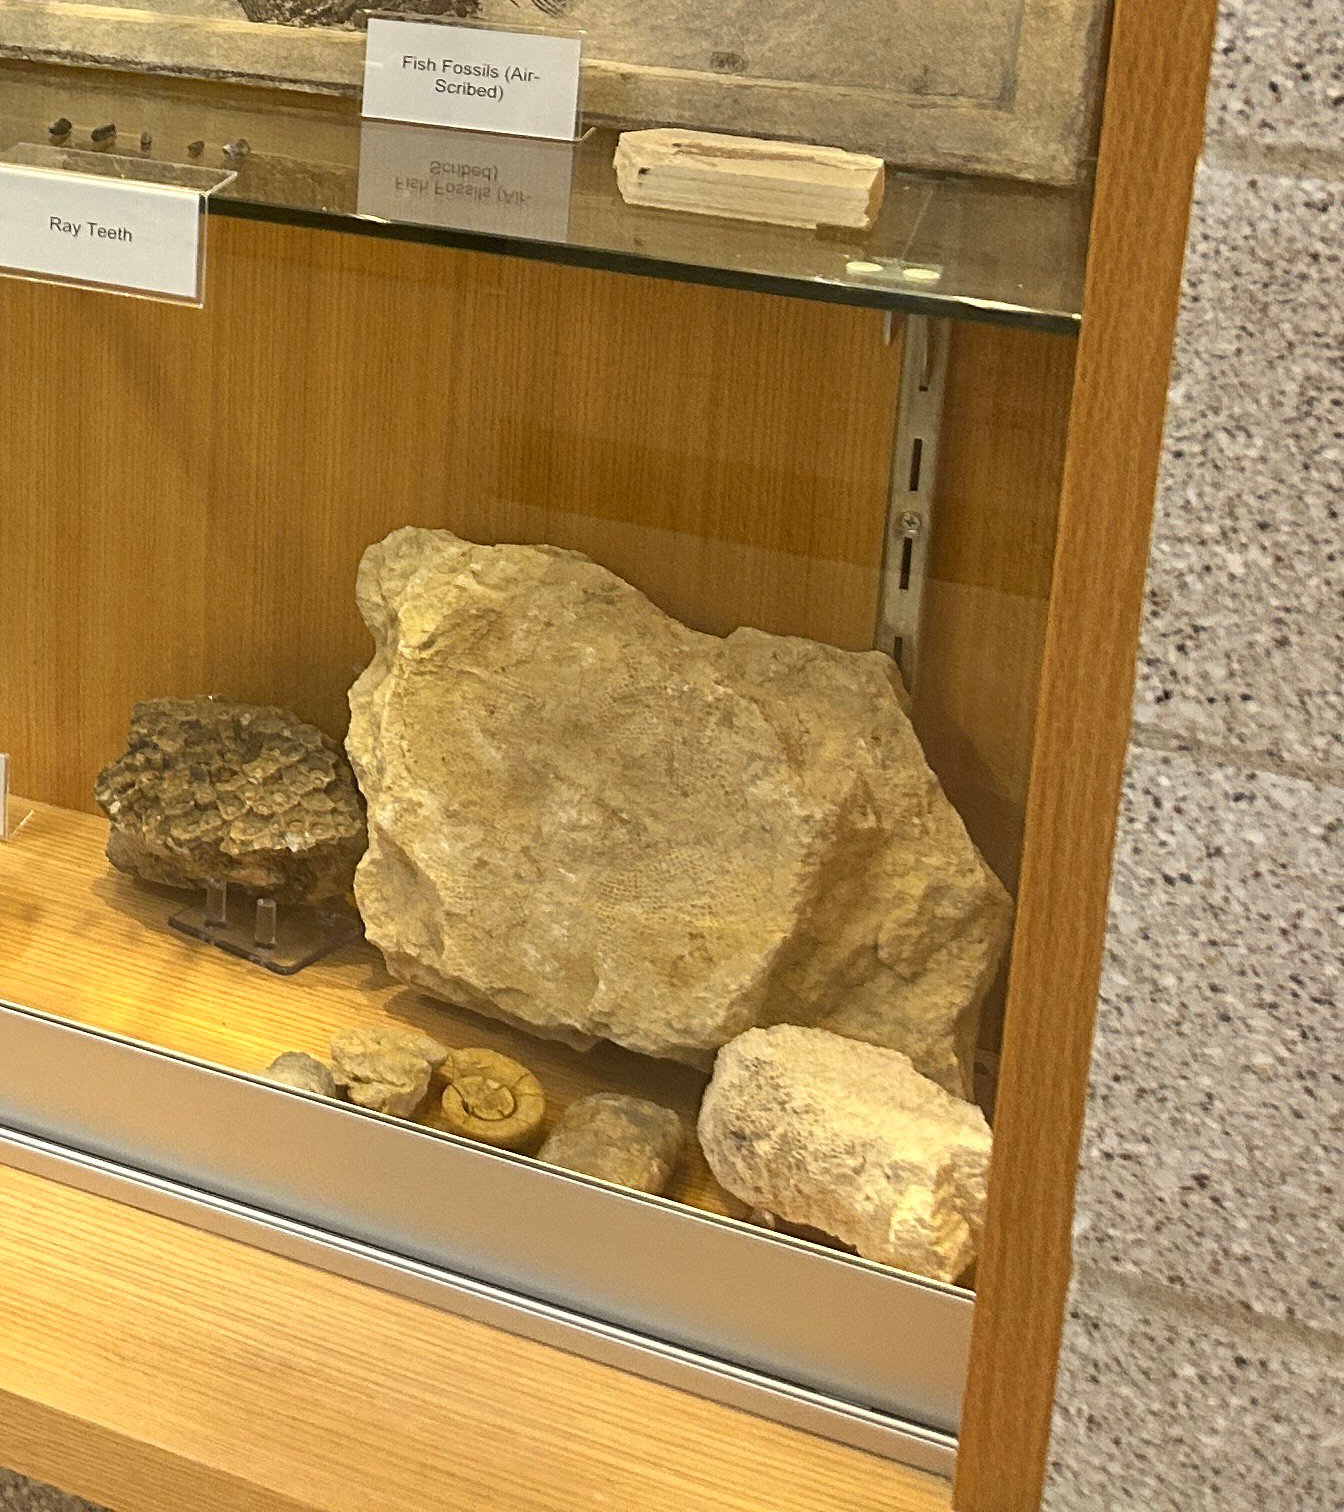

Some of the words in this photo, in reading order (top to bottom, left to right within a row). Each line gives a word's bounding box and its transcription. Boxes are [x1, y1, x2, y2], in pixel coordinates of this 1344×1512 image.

[402, 55, 436, 74] Fish
[442, 58, 499, 79] Fossils
[504, 63, 540, 84] (Air-
[434, 78, 504, 102] Scribed)
[50, 216, 82, 237] Ray
[88, 222, 132, 242] Teeth
